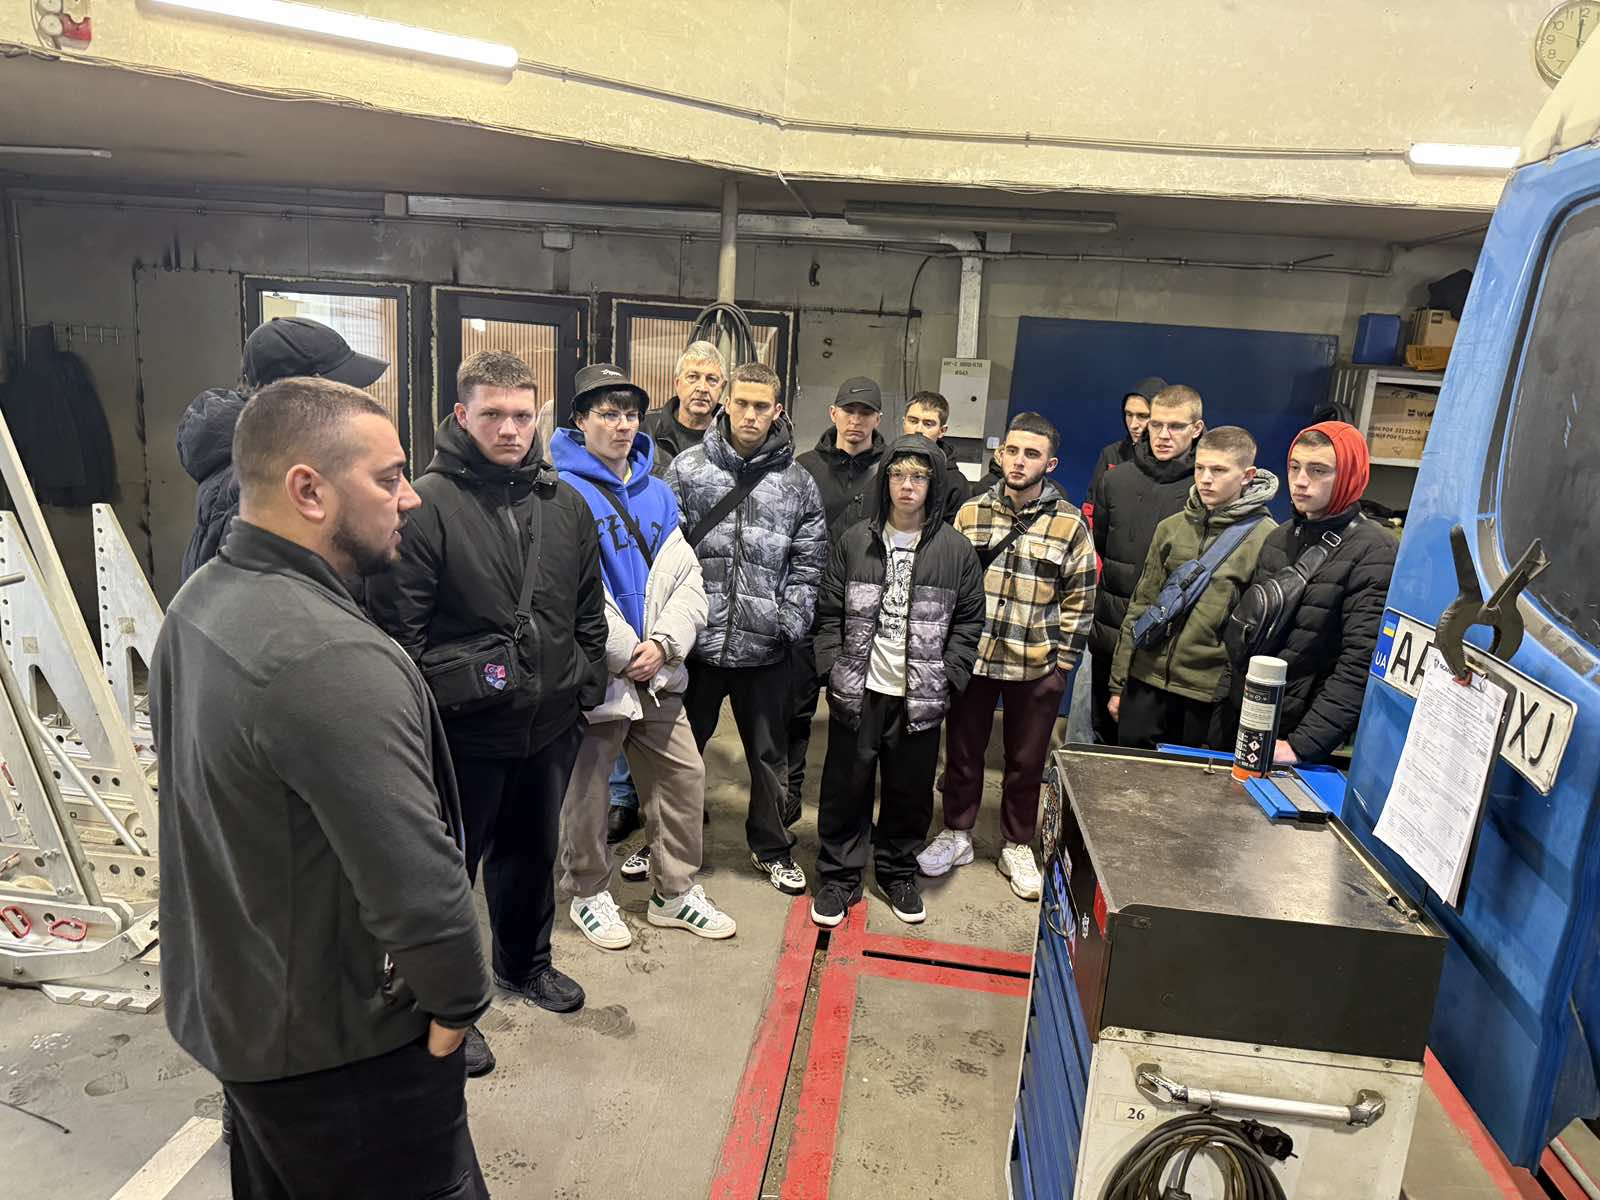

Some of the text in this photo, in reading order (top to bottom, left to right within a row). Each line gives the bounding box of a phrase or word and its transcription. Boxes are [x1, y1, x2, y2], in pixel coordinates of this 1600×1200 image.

[1545, 34, 1556, 45] 9
[1547, 49, 1557, 60] 8
[1375, 651, 1387, 670] UA
[1127, 1107, 1145, 1121] 26
